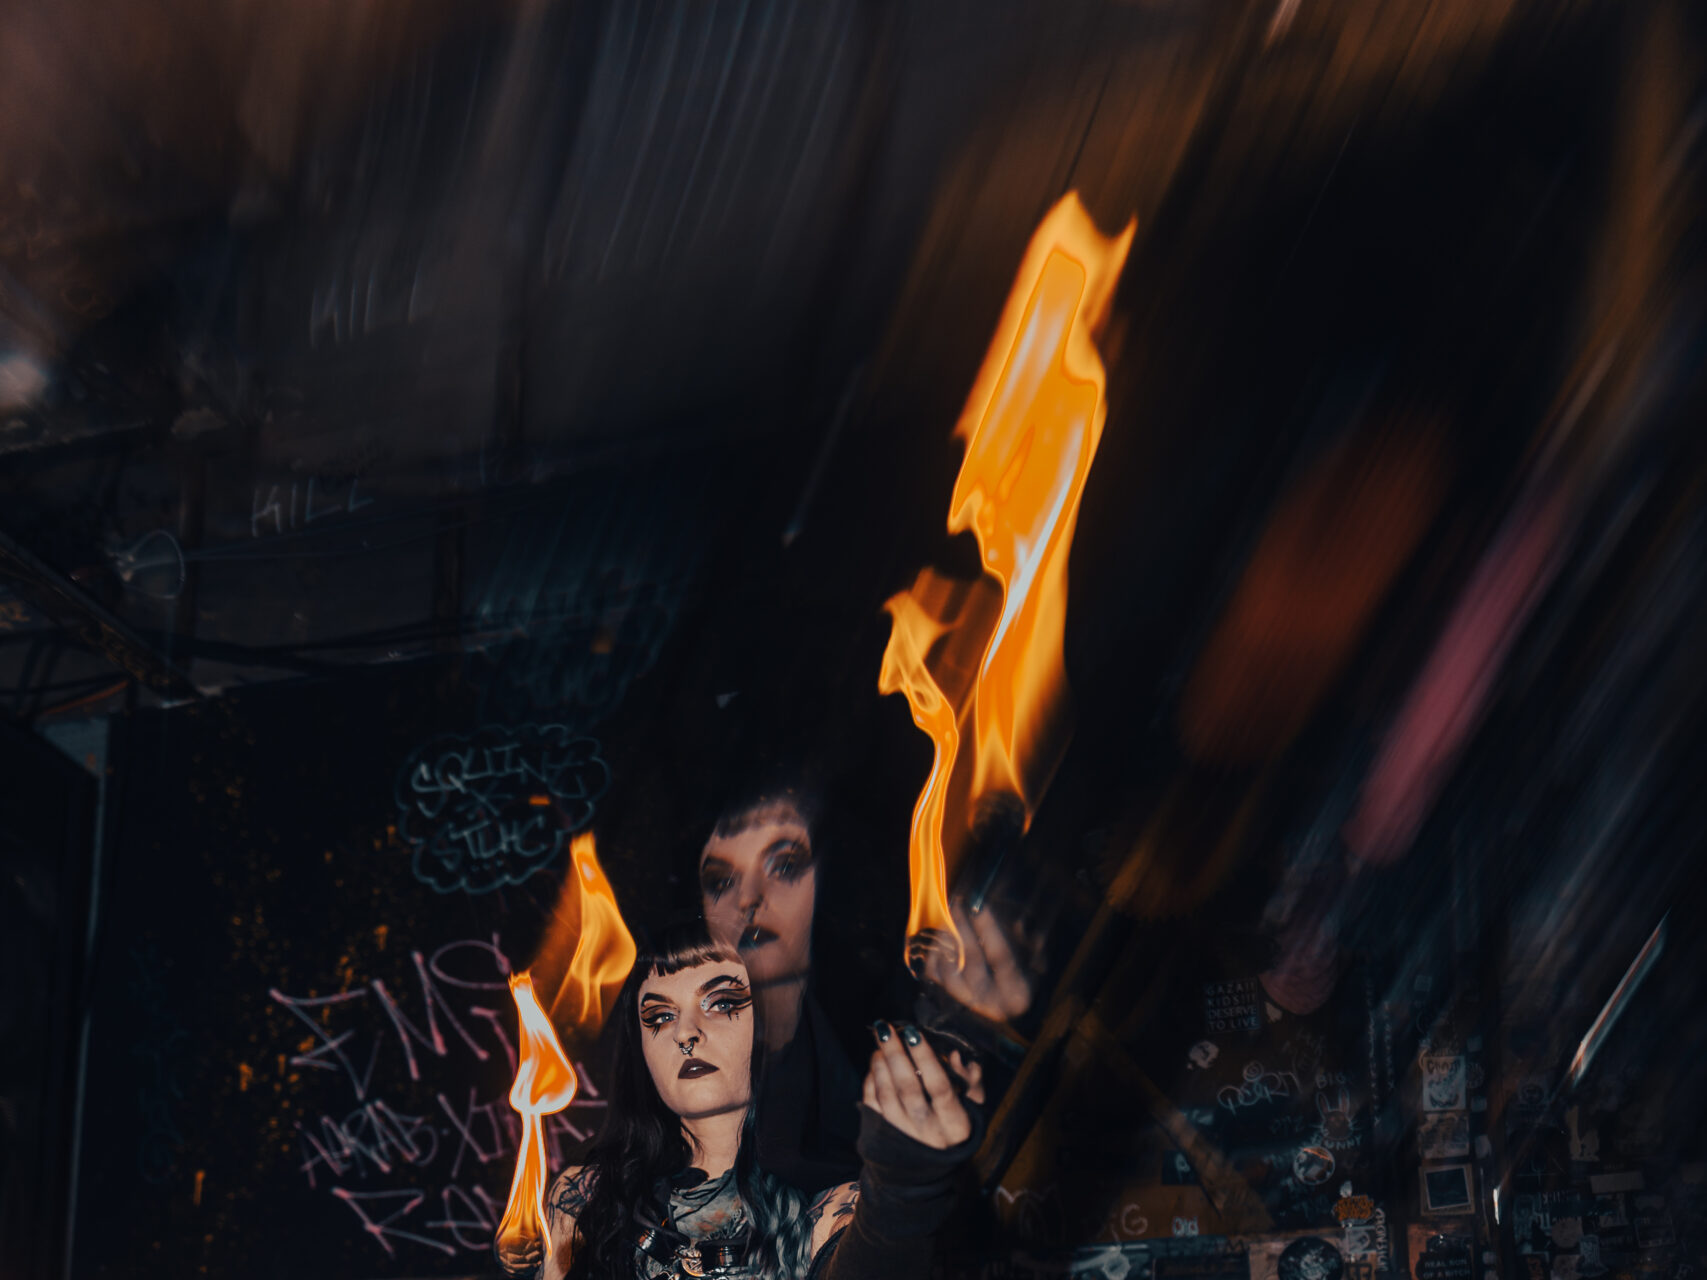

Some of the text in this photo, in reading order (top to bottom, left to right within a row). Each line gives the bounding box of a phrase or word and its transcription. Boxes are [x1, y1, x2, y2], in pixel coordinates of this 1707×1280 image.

[1208, 1006, 1258, 1021] DESERVE
[1208, 1016, 1259, 1032] TO LIVE
